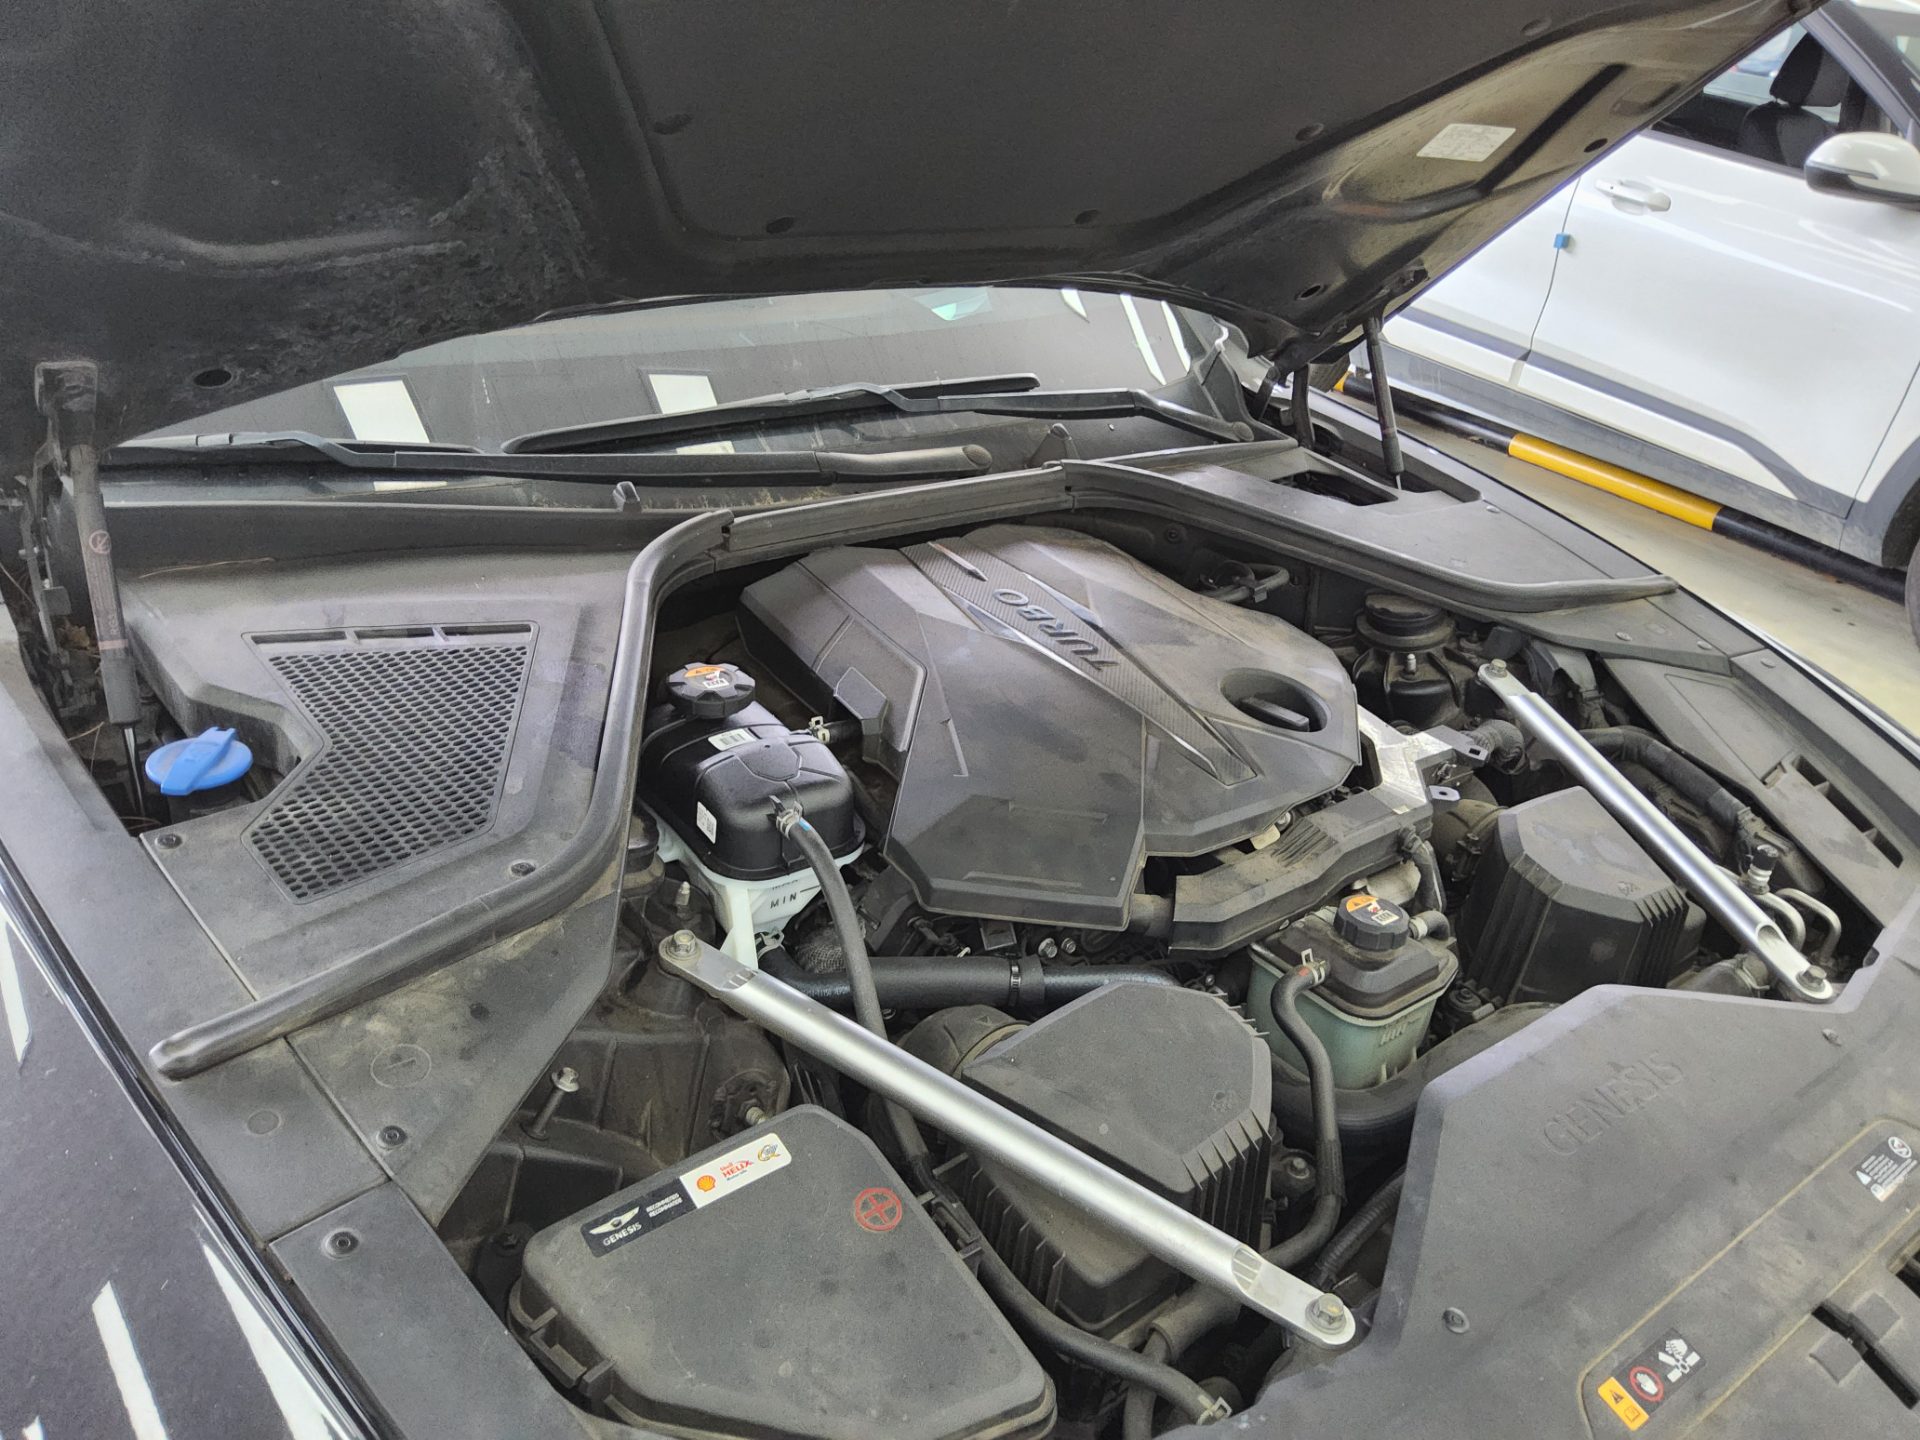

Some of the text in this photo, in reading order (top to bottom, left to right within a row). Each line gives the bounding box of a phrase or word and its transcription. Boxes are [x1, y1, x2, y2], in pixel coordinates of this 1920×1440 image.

[992, 588, 1120, 671] TURBO
[770, 892, 797, 908] MIN
[1543, 1051, 1684, 1156] GENESIS
[722, 1160, 752, 1178] HELIX
[602, 1221, 643, 1247] GENESIS
